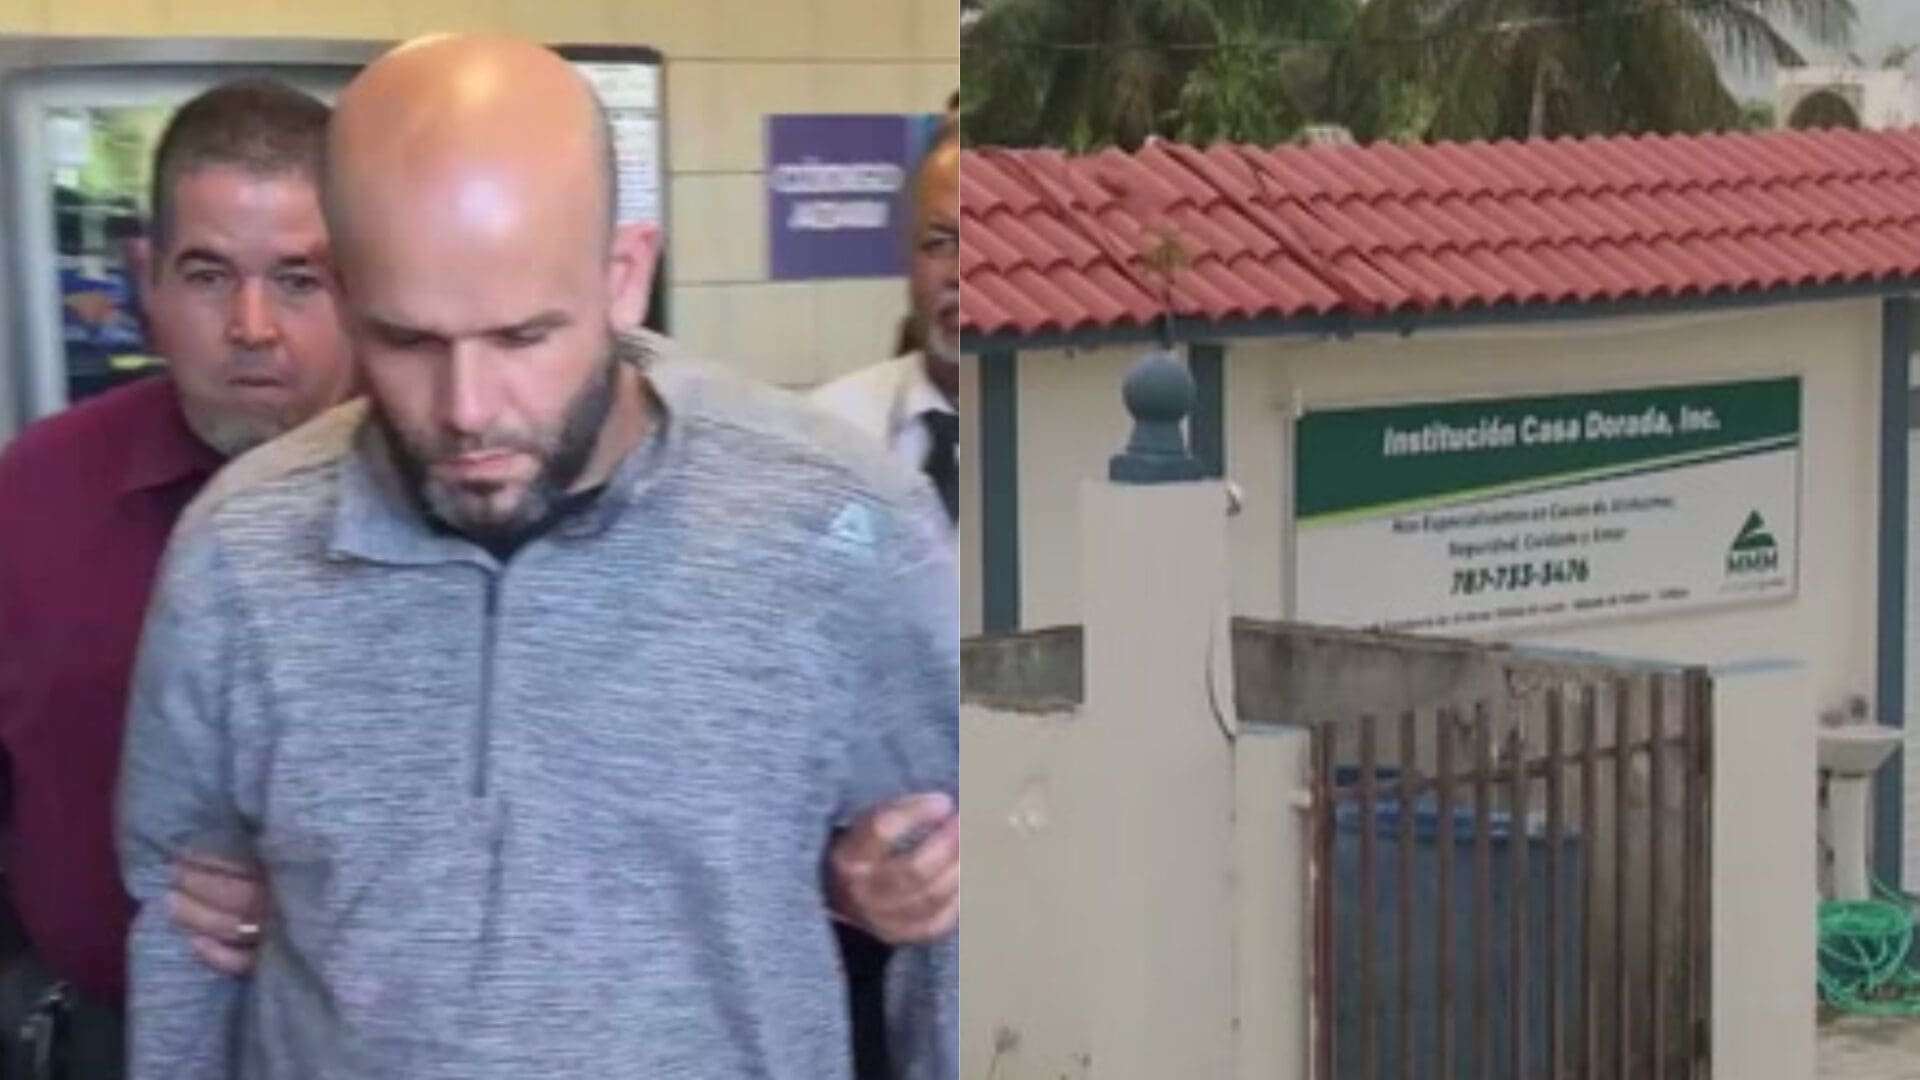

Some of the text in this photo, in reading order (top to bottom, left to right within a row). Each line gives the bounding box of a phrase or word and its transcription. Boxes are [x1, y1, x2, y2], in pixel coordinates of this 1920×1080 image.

[1383, 405, 1721, 456] Institución Casa Dorada, Inc.
[1726, 552, 1779, 575] MMM
